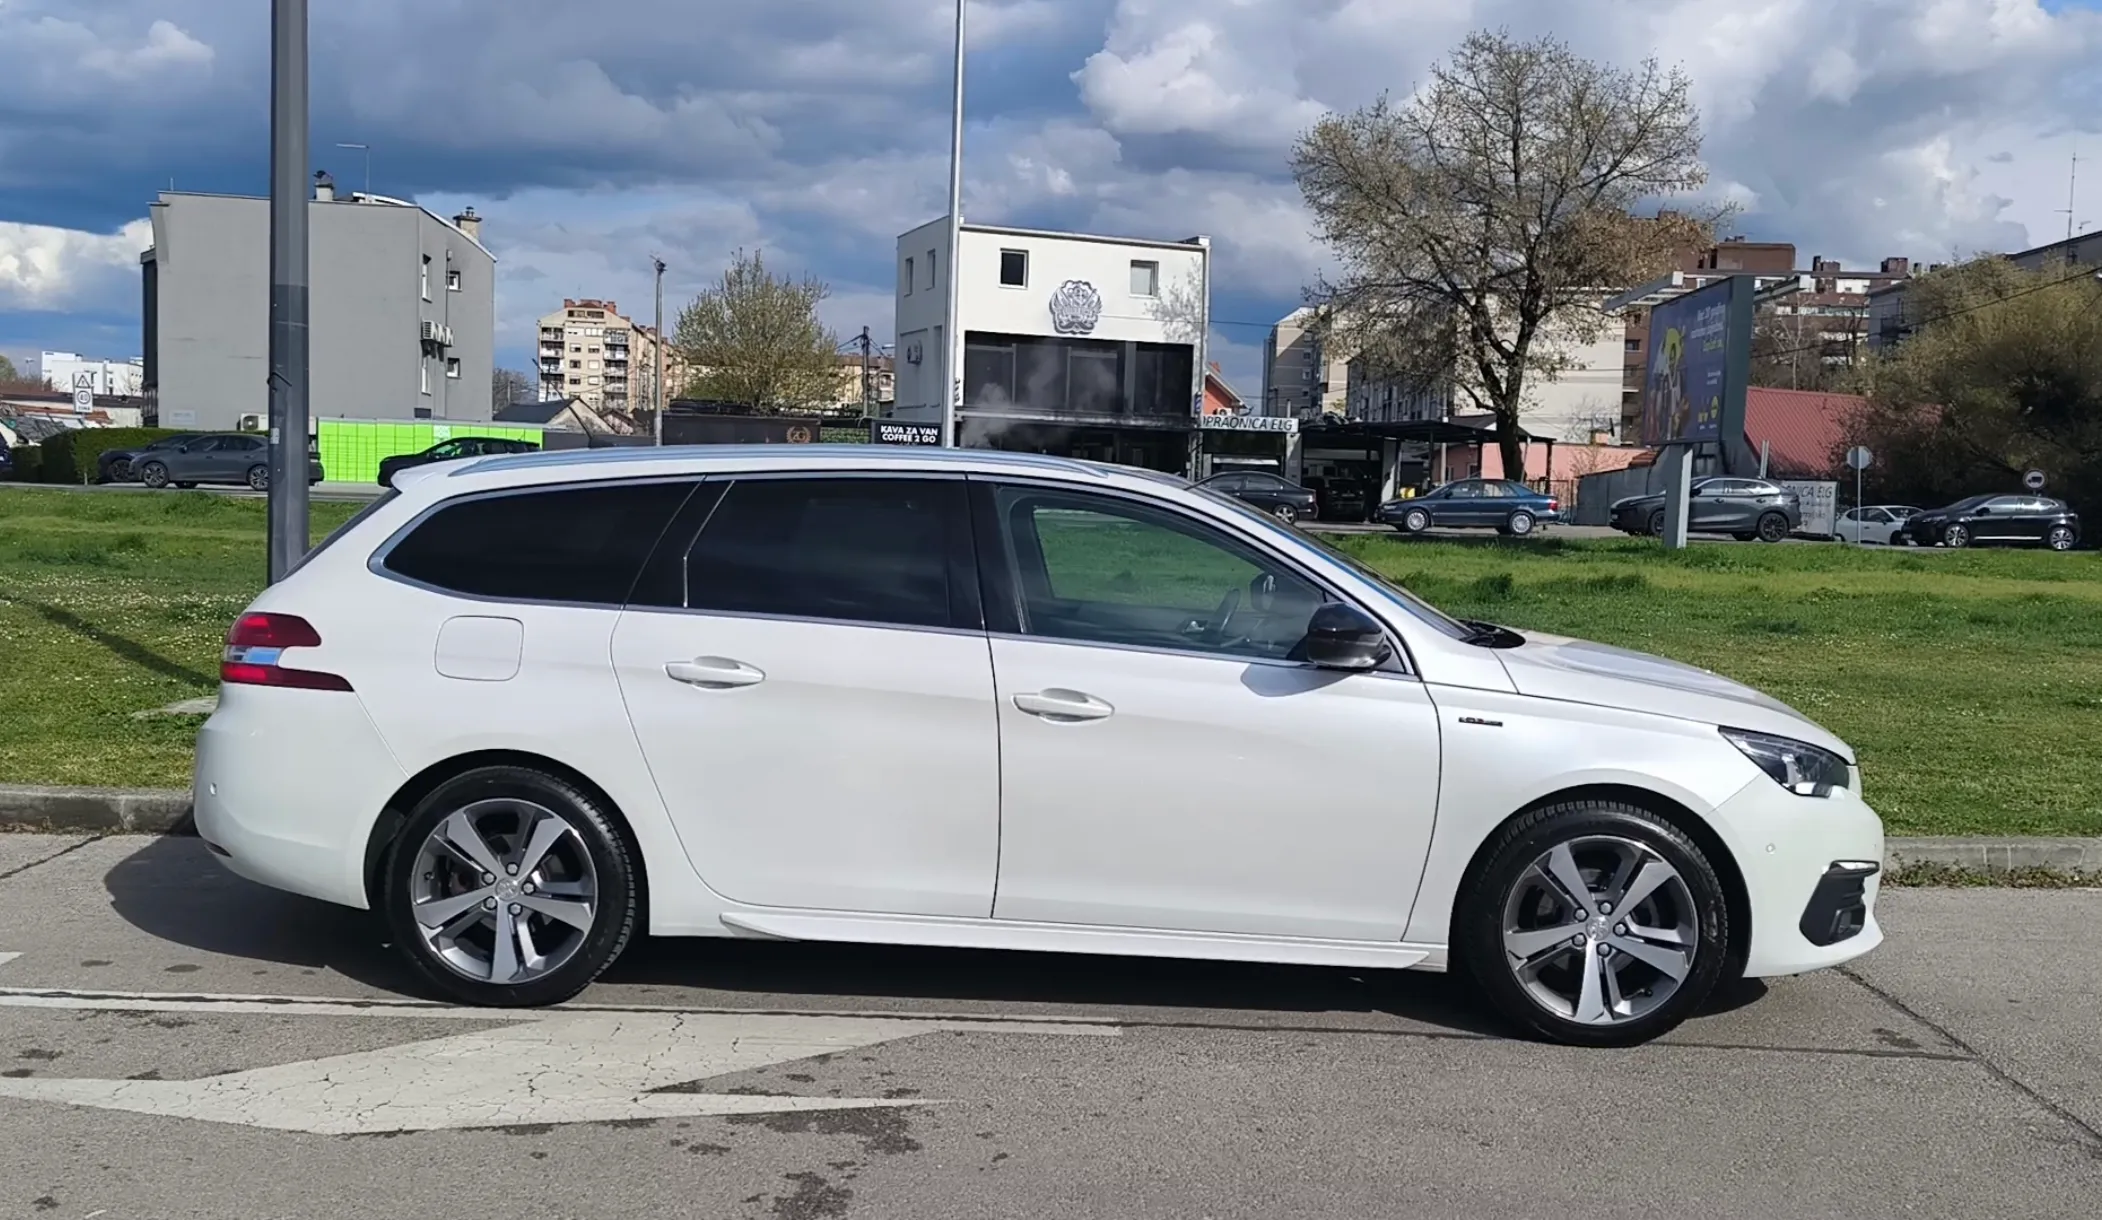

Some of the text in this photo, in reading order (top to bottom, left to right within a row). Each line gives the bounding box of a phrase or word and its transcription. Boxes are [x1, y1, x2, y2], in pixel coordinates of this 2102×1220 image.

[1271, 418, 1293, 431] ELG
[880, 425, 904, 434] KAVA
[906, 427, 918, 435] ZA
[882, 434, 912, 442] COFFEE
[922, 435, 936, 443] GO
